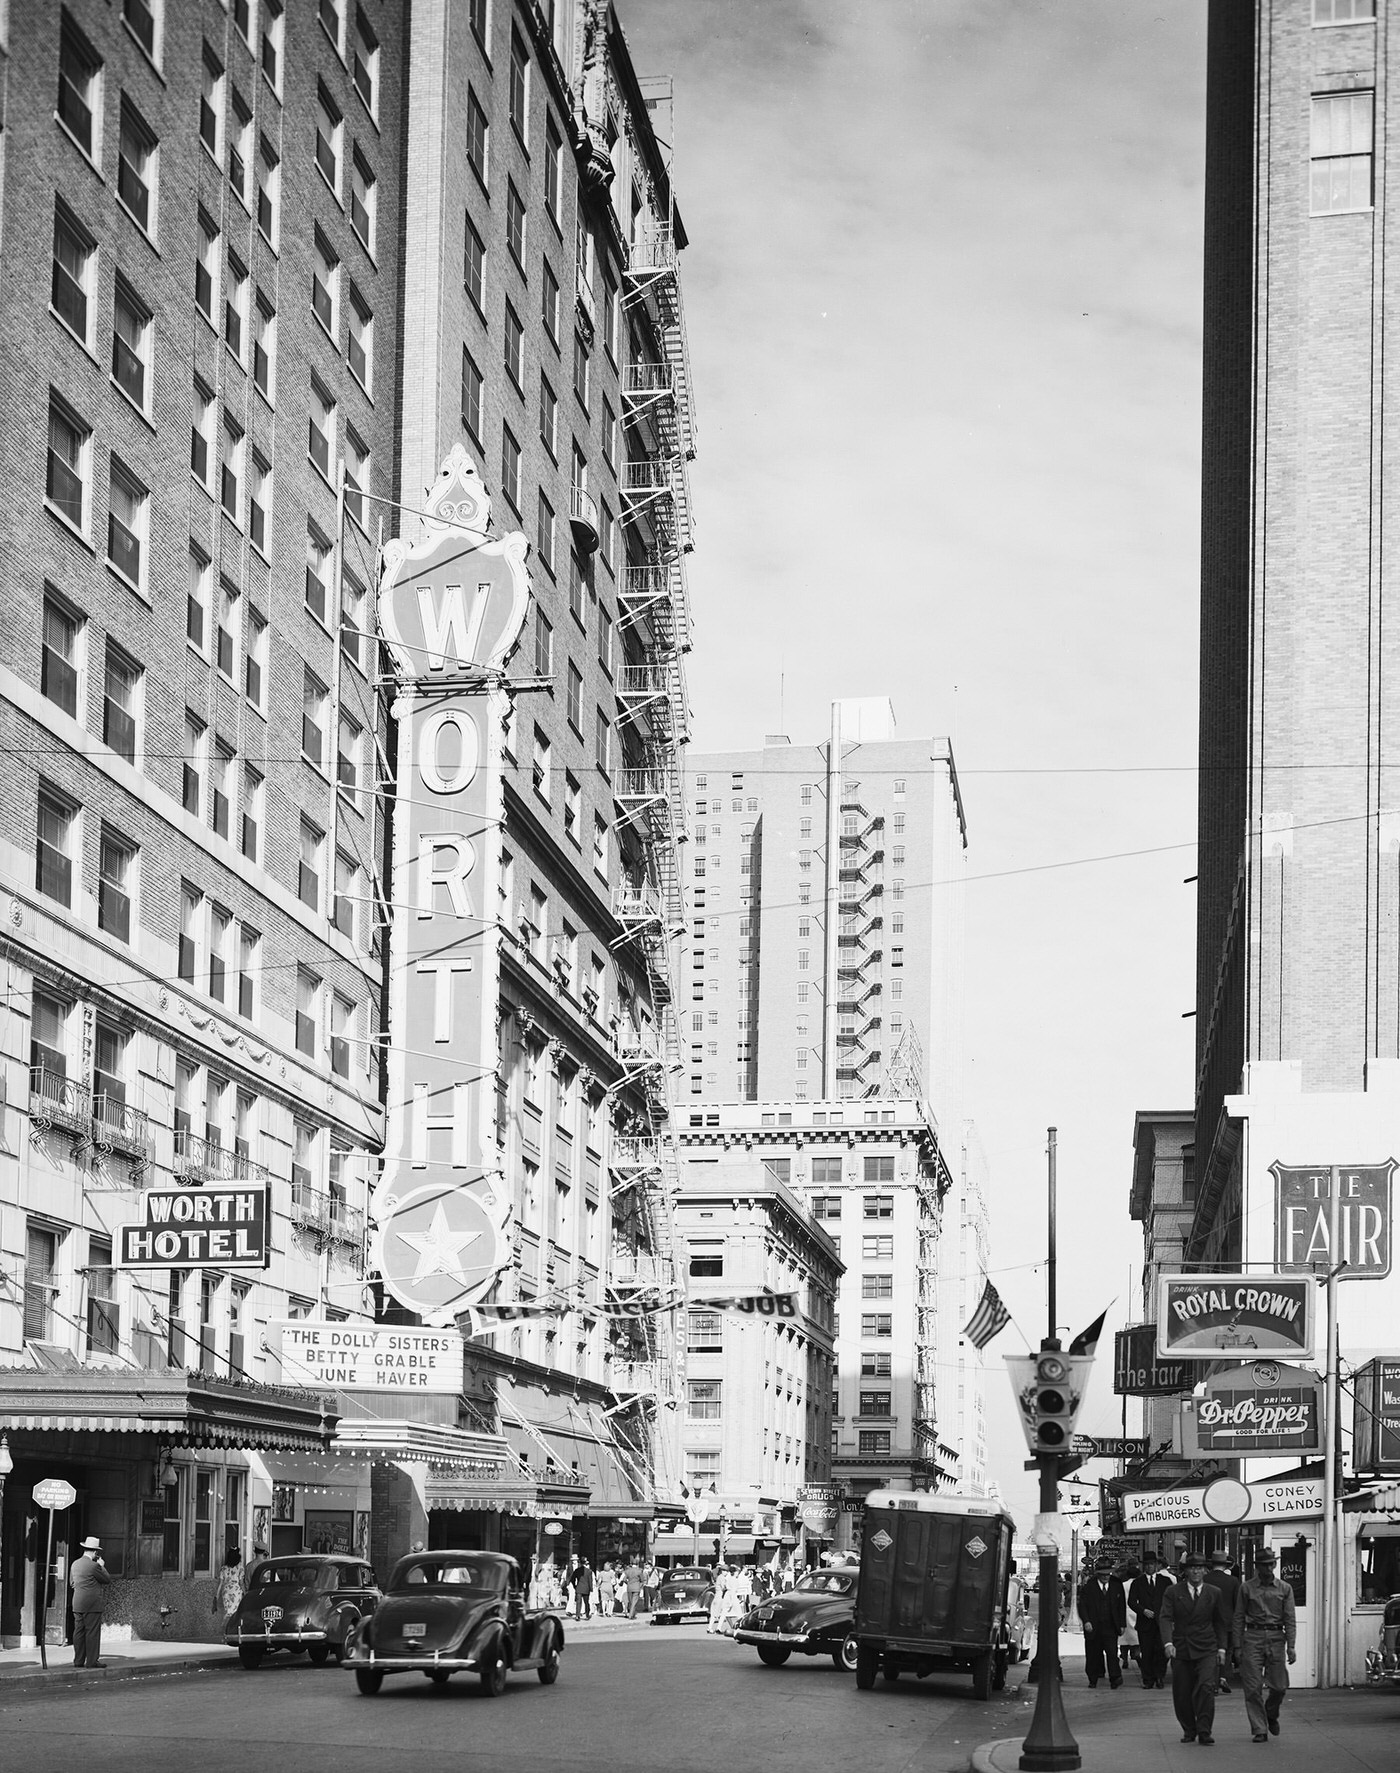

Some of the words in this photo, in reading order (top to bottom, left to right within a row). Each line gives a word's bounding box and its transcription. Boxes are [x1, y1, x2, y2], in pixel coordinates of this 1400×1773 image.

[411, 583, 491, 1168] WORTH
[1309, 1175, 1360, 1198] THE
[149, 1194, 255, 1223] WORTH
[128, 1229, 259, 1259] HOTEL
[1285, 1205, 1383, 1267] FAIR
[1173, 1286, 1200, 1294] DRINK
[737, 1294, 796, 1317] JOB
[1172, 1290, 1231, 1322] ROYAL
[1234, 1288, 1302, 1322] CROWN
[331, 1333, 379, 1348] DOLLY
[306, 1349, 359, 1365] BETTY
[374, 1353, 436, 1368] GRABLE
[1117, 1335, 1146, 1389] the
[1151, 1338, 1183, 1387] fair
[315, 1368, 357, 1383] JUNE
[376, 1371, 428, 1386] HAVER
[41, 1487, 69, 1495] PARKING
[1265, 1485, 1316, 1498] CONEY
[1133, 1495, 1191, 1509] DELICIOUS
[1263, 1498, 1323, 1513] ISLANDS
[1130, 1508, 1201, 1523] HAMBURGERS
